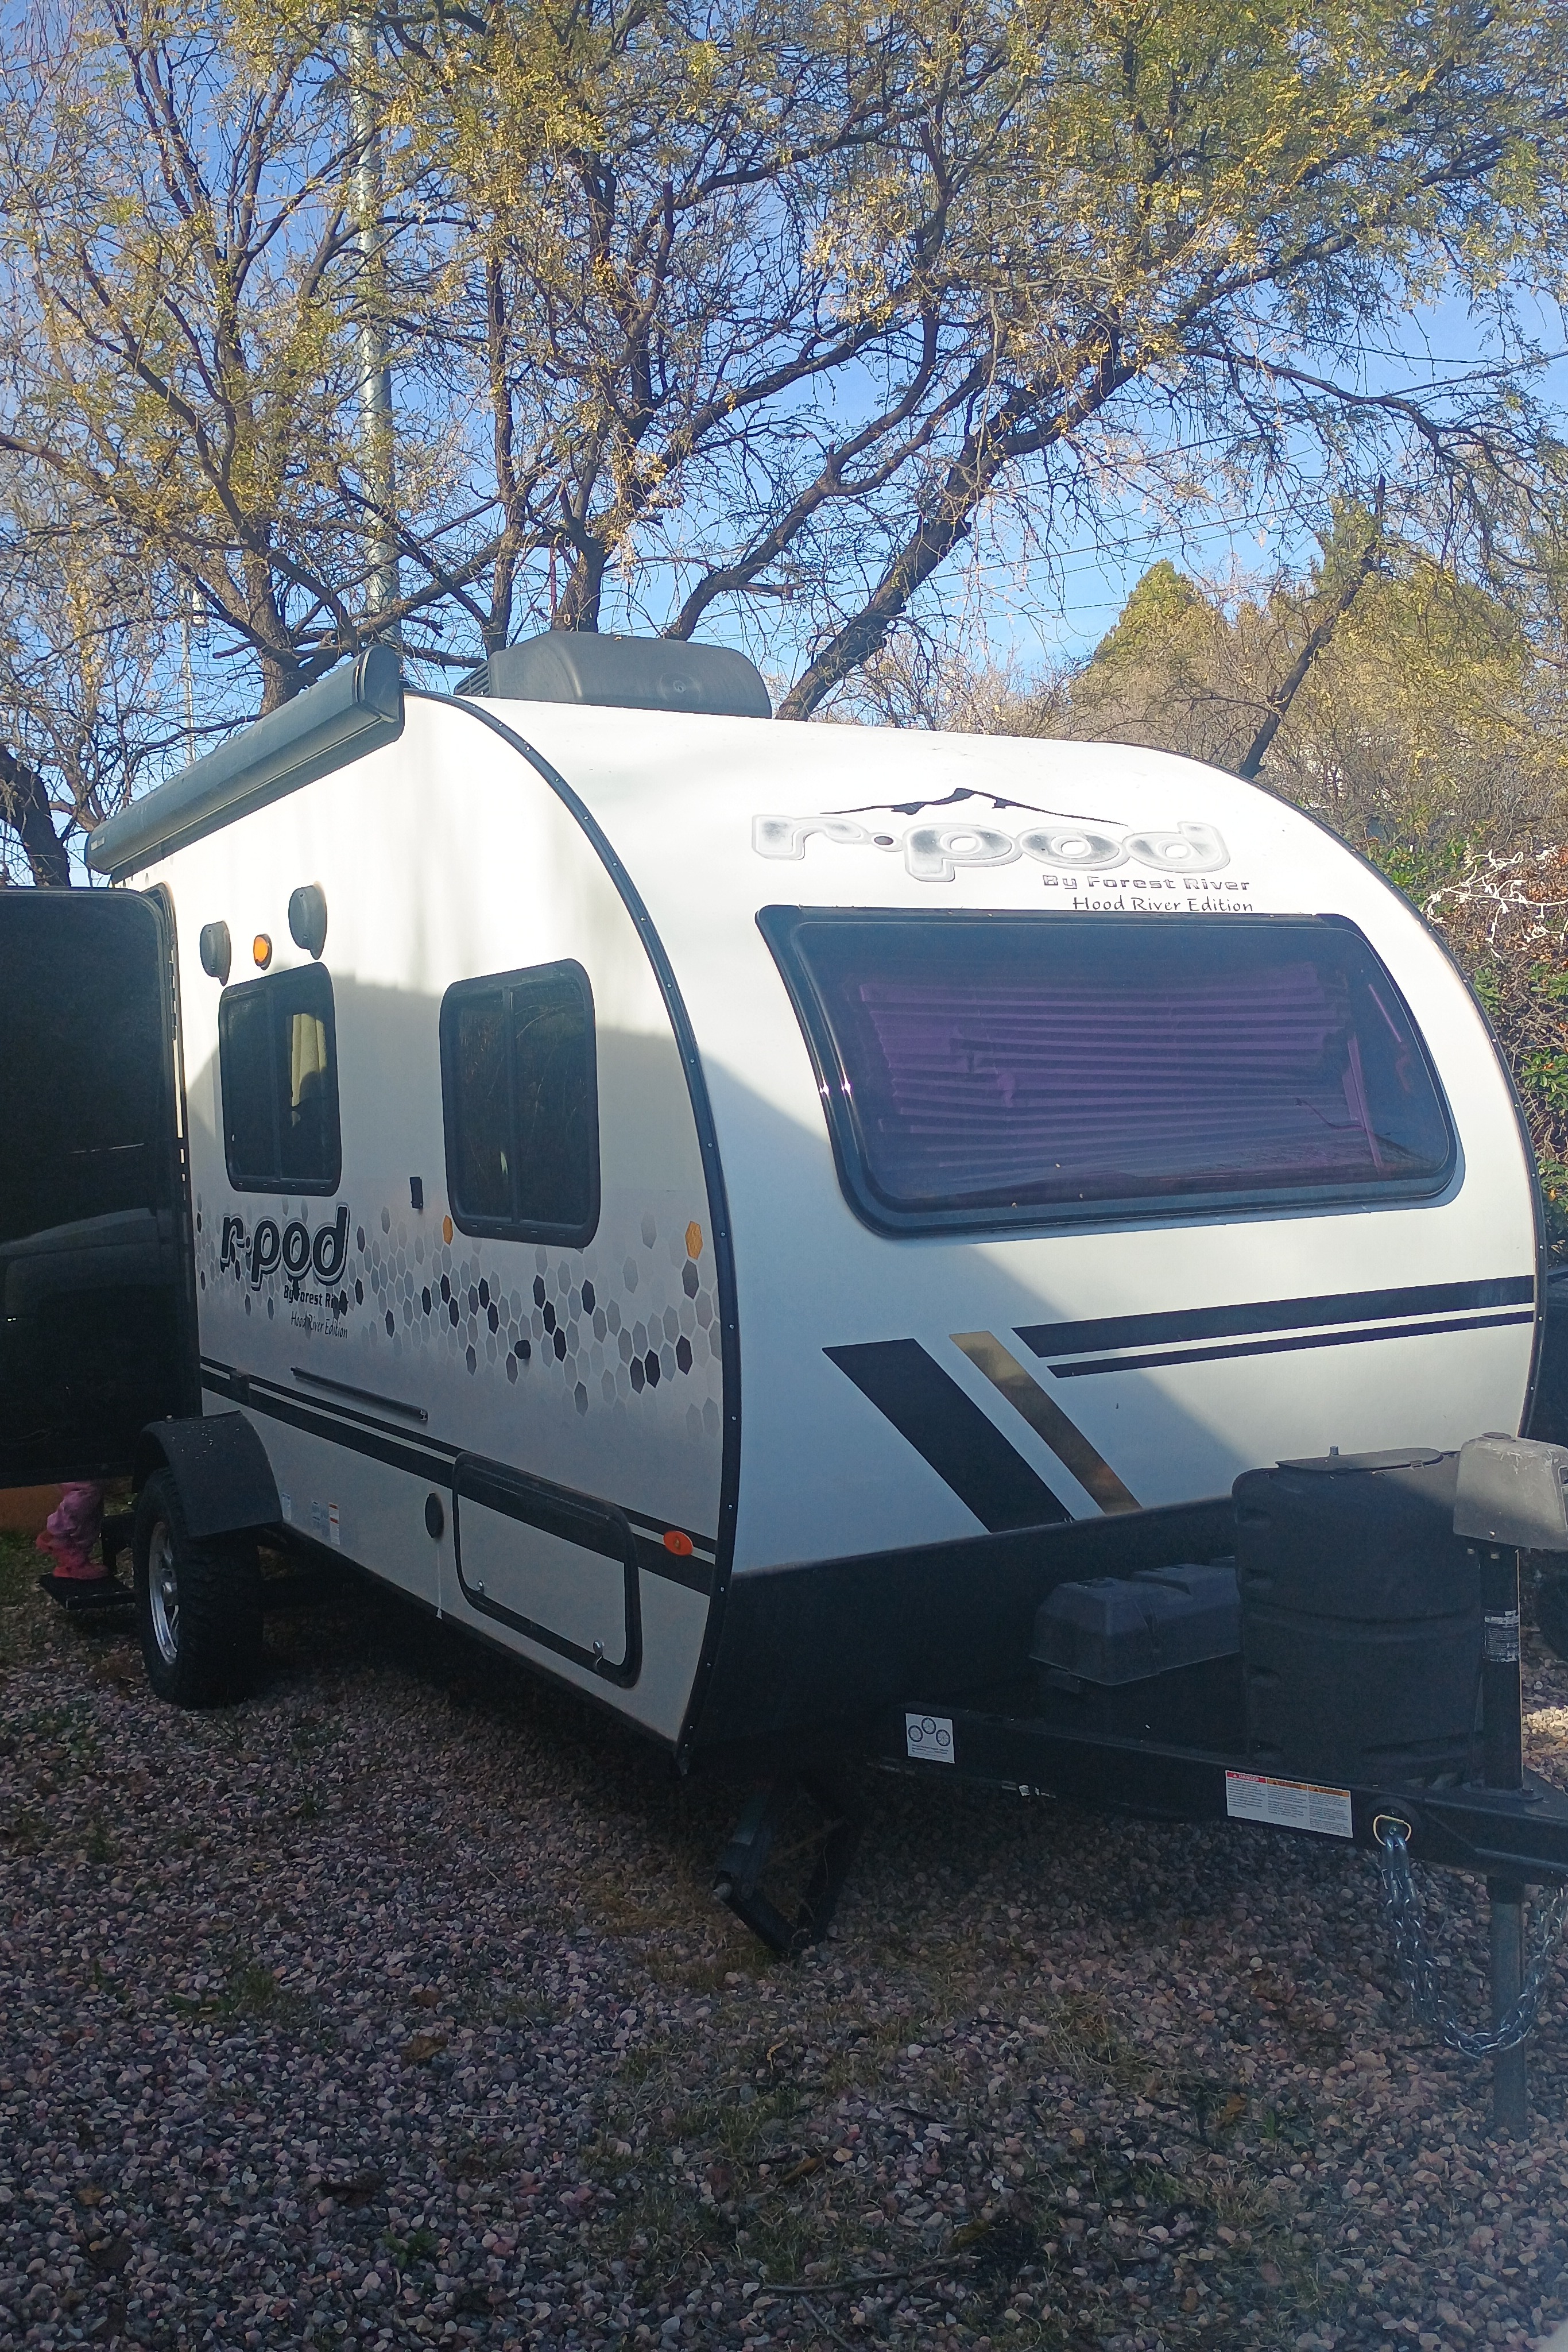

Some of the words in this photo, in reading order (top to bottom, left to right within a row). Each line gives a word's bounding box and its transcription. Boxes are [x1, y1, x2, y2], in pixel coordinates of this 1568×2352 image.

[1042, 875, 1078, 889] By
[1086, 876, 1176, 889] Forest
[1183, 877, 1250, 891] River
[1073, 895, 1124, 911] Hood
[1130, 897, 1181, 912] River
[1187, 896, 1253, 912] Edition
[293, 1287, 323, 1306] orest
[324, 1317, 348, 1339] Edition
